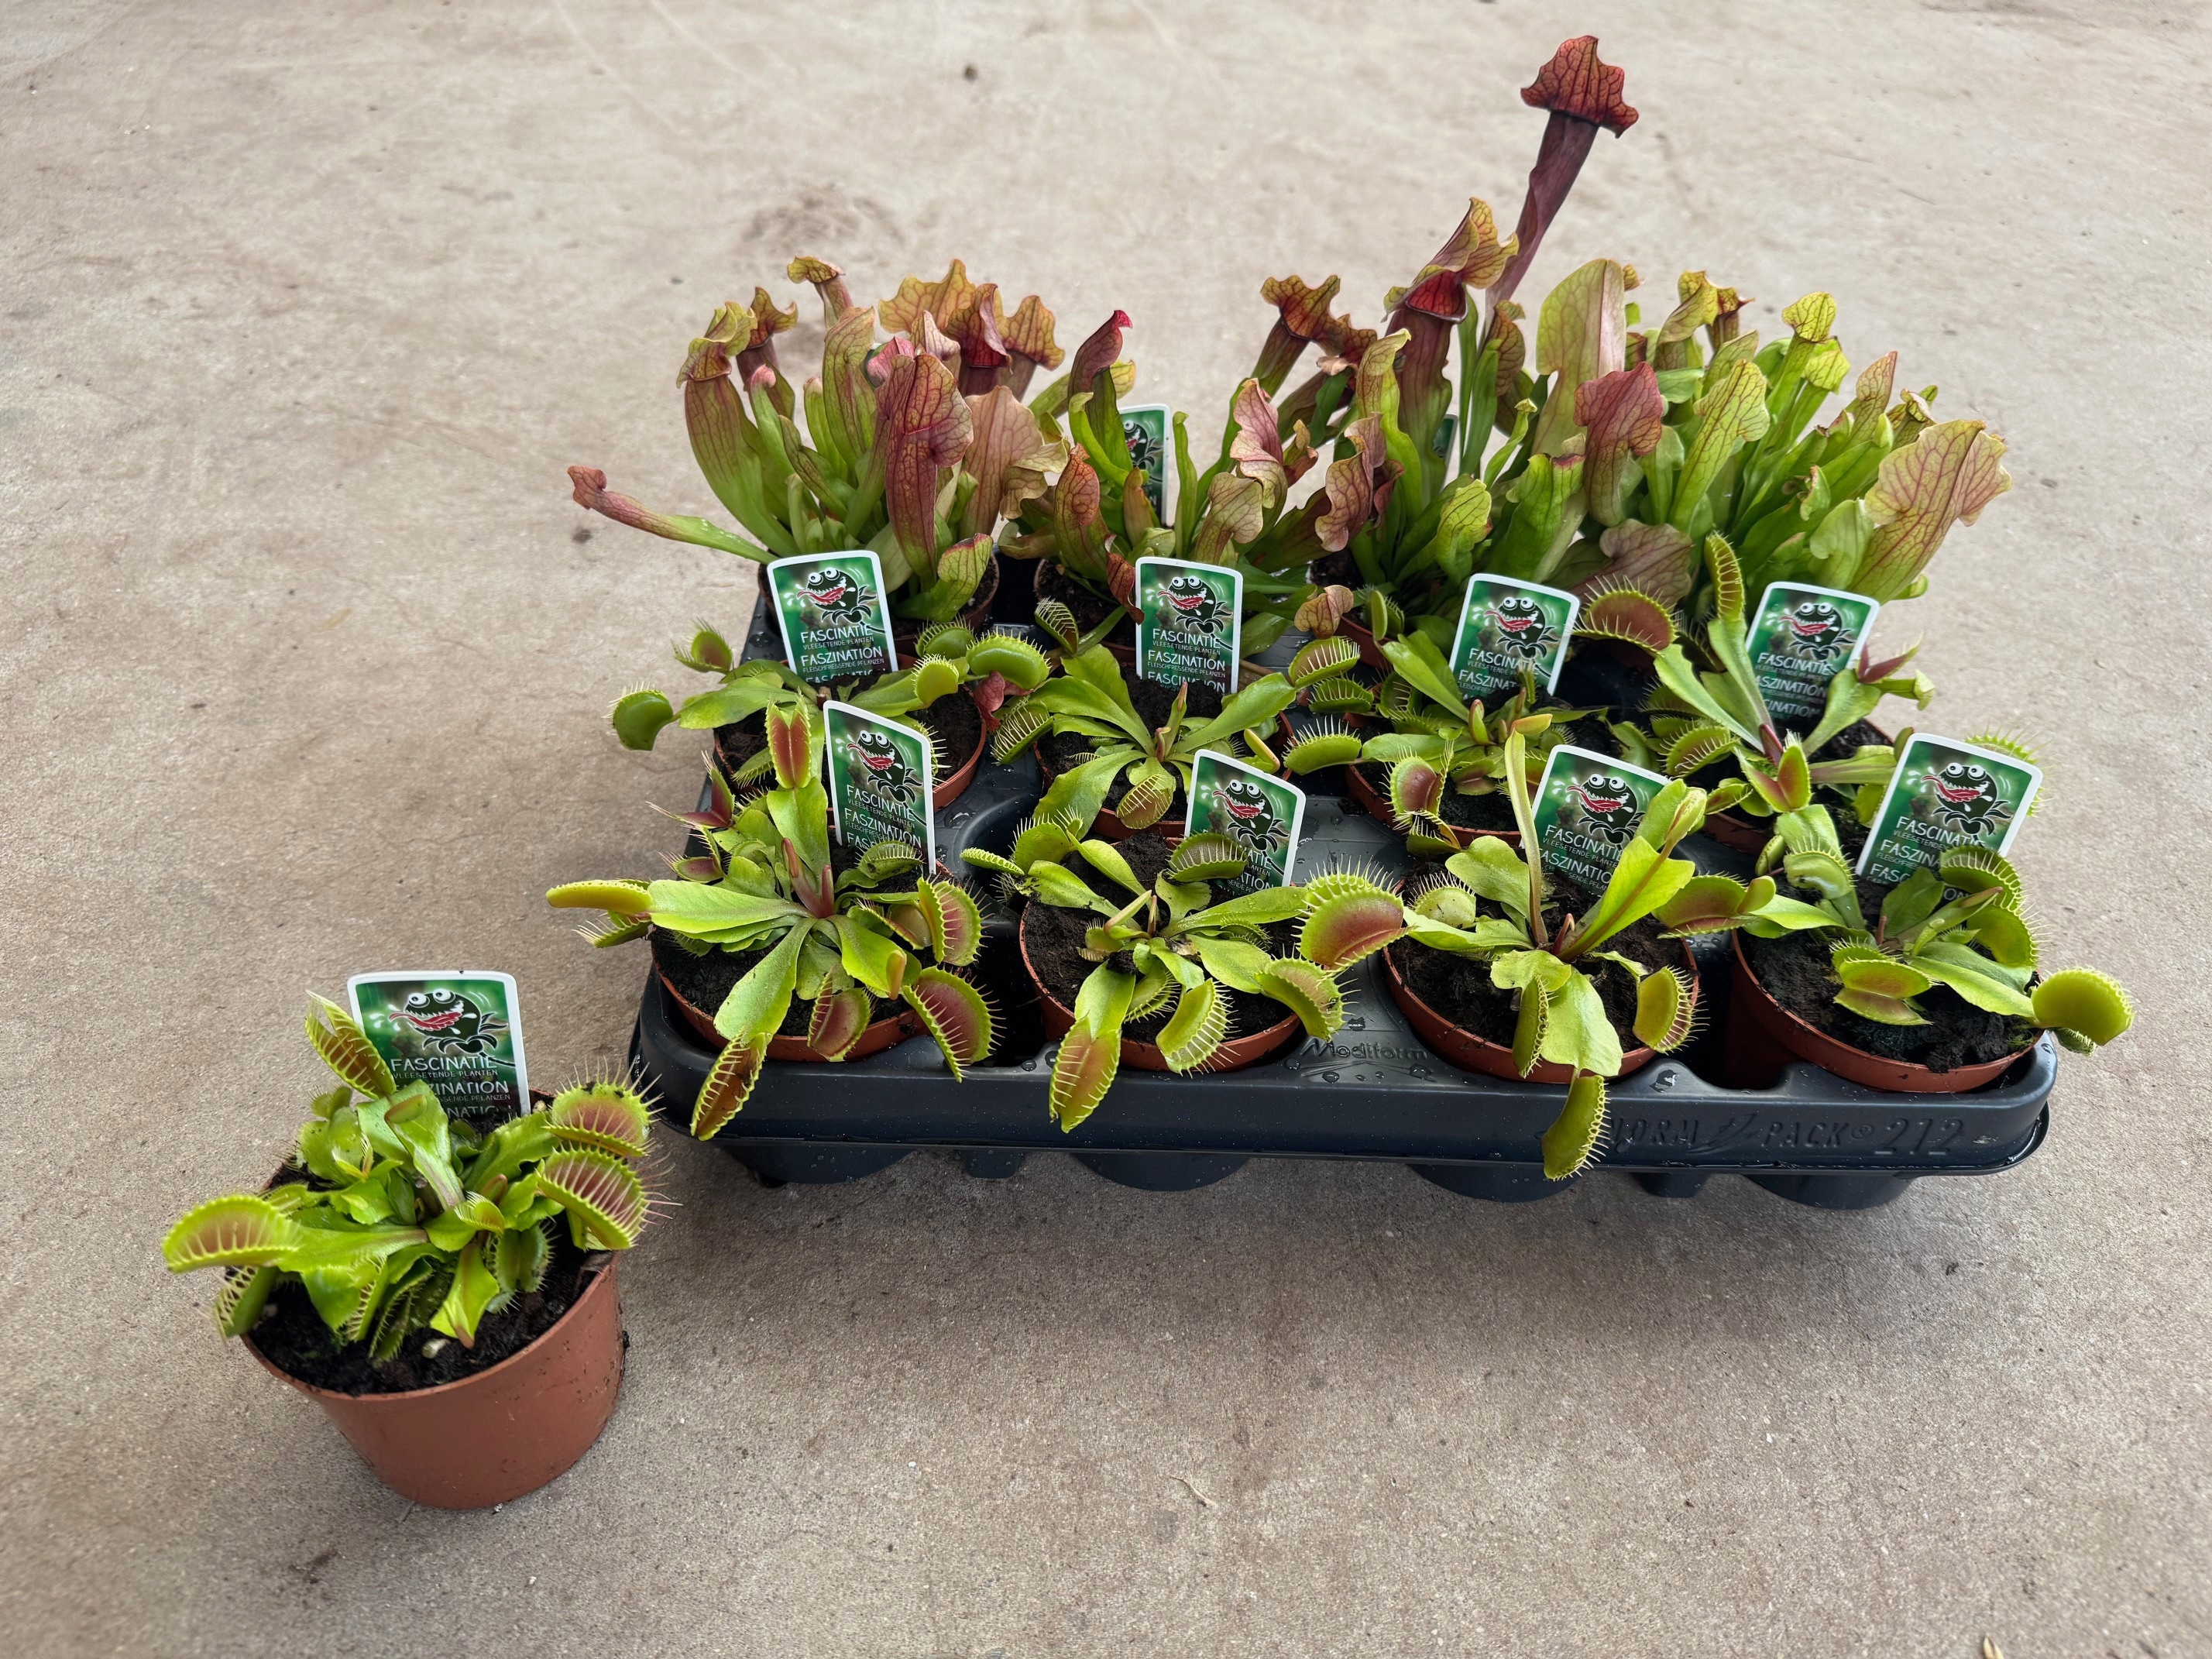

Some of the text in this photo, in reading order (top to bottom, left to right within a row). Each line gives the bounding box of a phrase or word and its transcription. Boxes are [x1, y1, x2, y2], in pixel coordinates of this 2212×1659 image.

[801, 624, 873, 643] FASCINATIE
[1152, 628, 1221, 648] FASCINATIE
[801, 646, 882, 666] FASZINATION
[803, 641, 846, 650] VLEESETENDE
[1152, 641, 1221, 655] VLEESETENDE PLANTEN
[1148, 650, 1225, 671] FASZINATION
[1148, 661, 1225, 678] FLEISCHFRESSENDE PFLANZEN
[1757, 653, 1832, 675] FASCINATIE
[1459, 670, 1516, 689] FASZINAT
[1756, 675, 1828, 697] ASZINATION
[847, 785, 915, 821] FASCINATIE
[848, 799, 915, 828] VLEESETENDE PLANTEN
[845, 808, 922, 848] FASZINATION
[1543, 838, 1617, 867] VLEESETENDE PLANTE
[1881, 840, 1940, 867] FASZINA
[1247, 864, 1270, 877] LANTEN
[1540, 847, 1613, 884] ASZINATIO
[1300, 1037, 1427, 1060] Modiform
[390, 1056, 497, 1071] FASCINATIE
[393, 1071, 455, 1080] VLEESETENDE
[1874, 1118, 1963, 1155] 212
